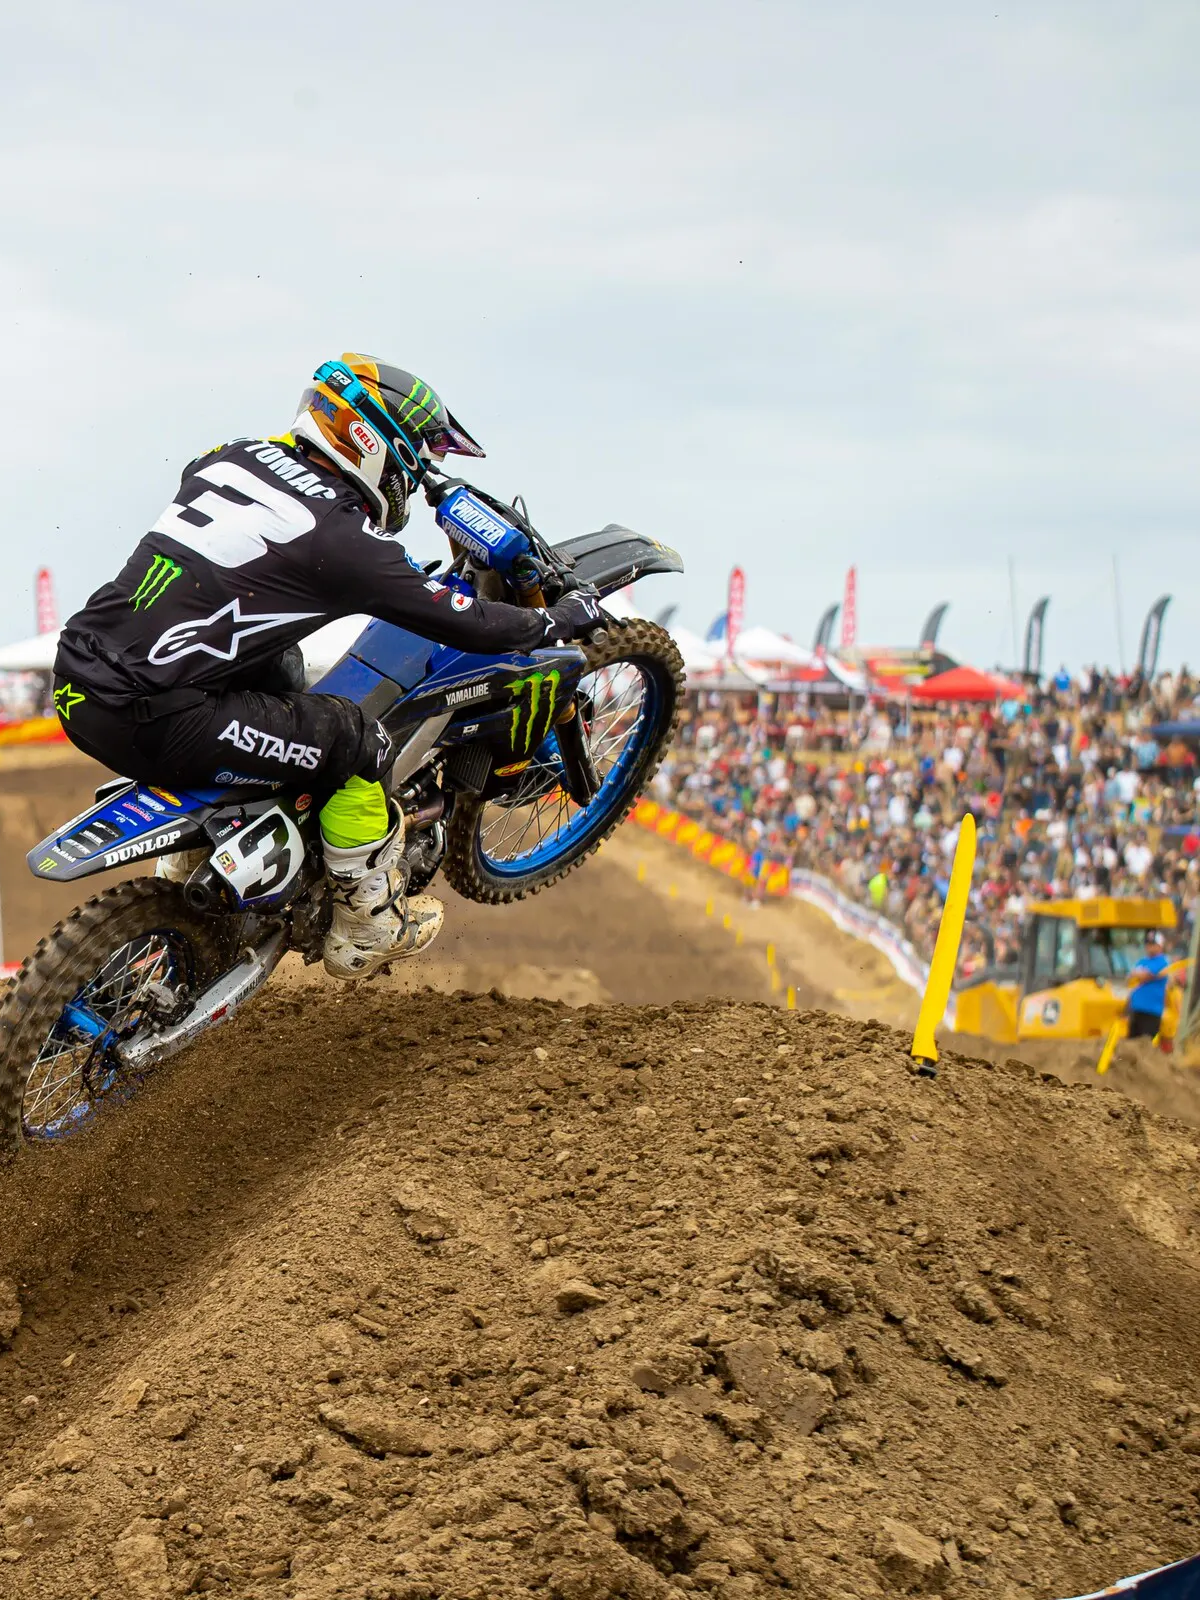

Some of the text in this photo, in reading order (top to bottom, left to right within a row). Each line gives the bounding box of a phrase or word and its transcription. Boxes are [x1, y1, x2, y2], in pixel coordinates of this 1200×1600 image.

[331, 370, 352, 386] ET3
[354, 426, 376, 452] BELL
[244, 440, 337, 500] TOMAC
[150, 461, 317, 569] 3
[451, 500, 501, 544] PROTAPER
[443, 521, 488, 561] PROTAPER
[445, 682, 489, 706] YAMALUBE
[217, 719, 322, 770] ASTARS
[104, 830, 181, 867] DUNLOP
[216, 824, 235, 838] TOMAC
[237, 813, 292, 900] 3
